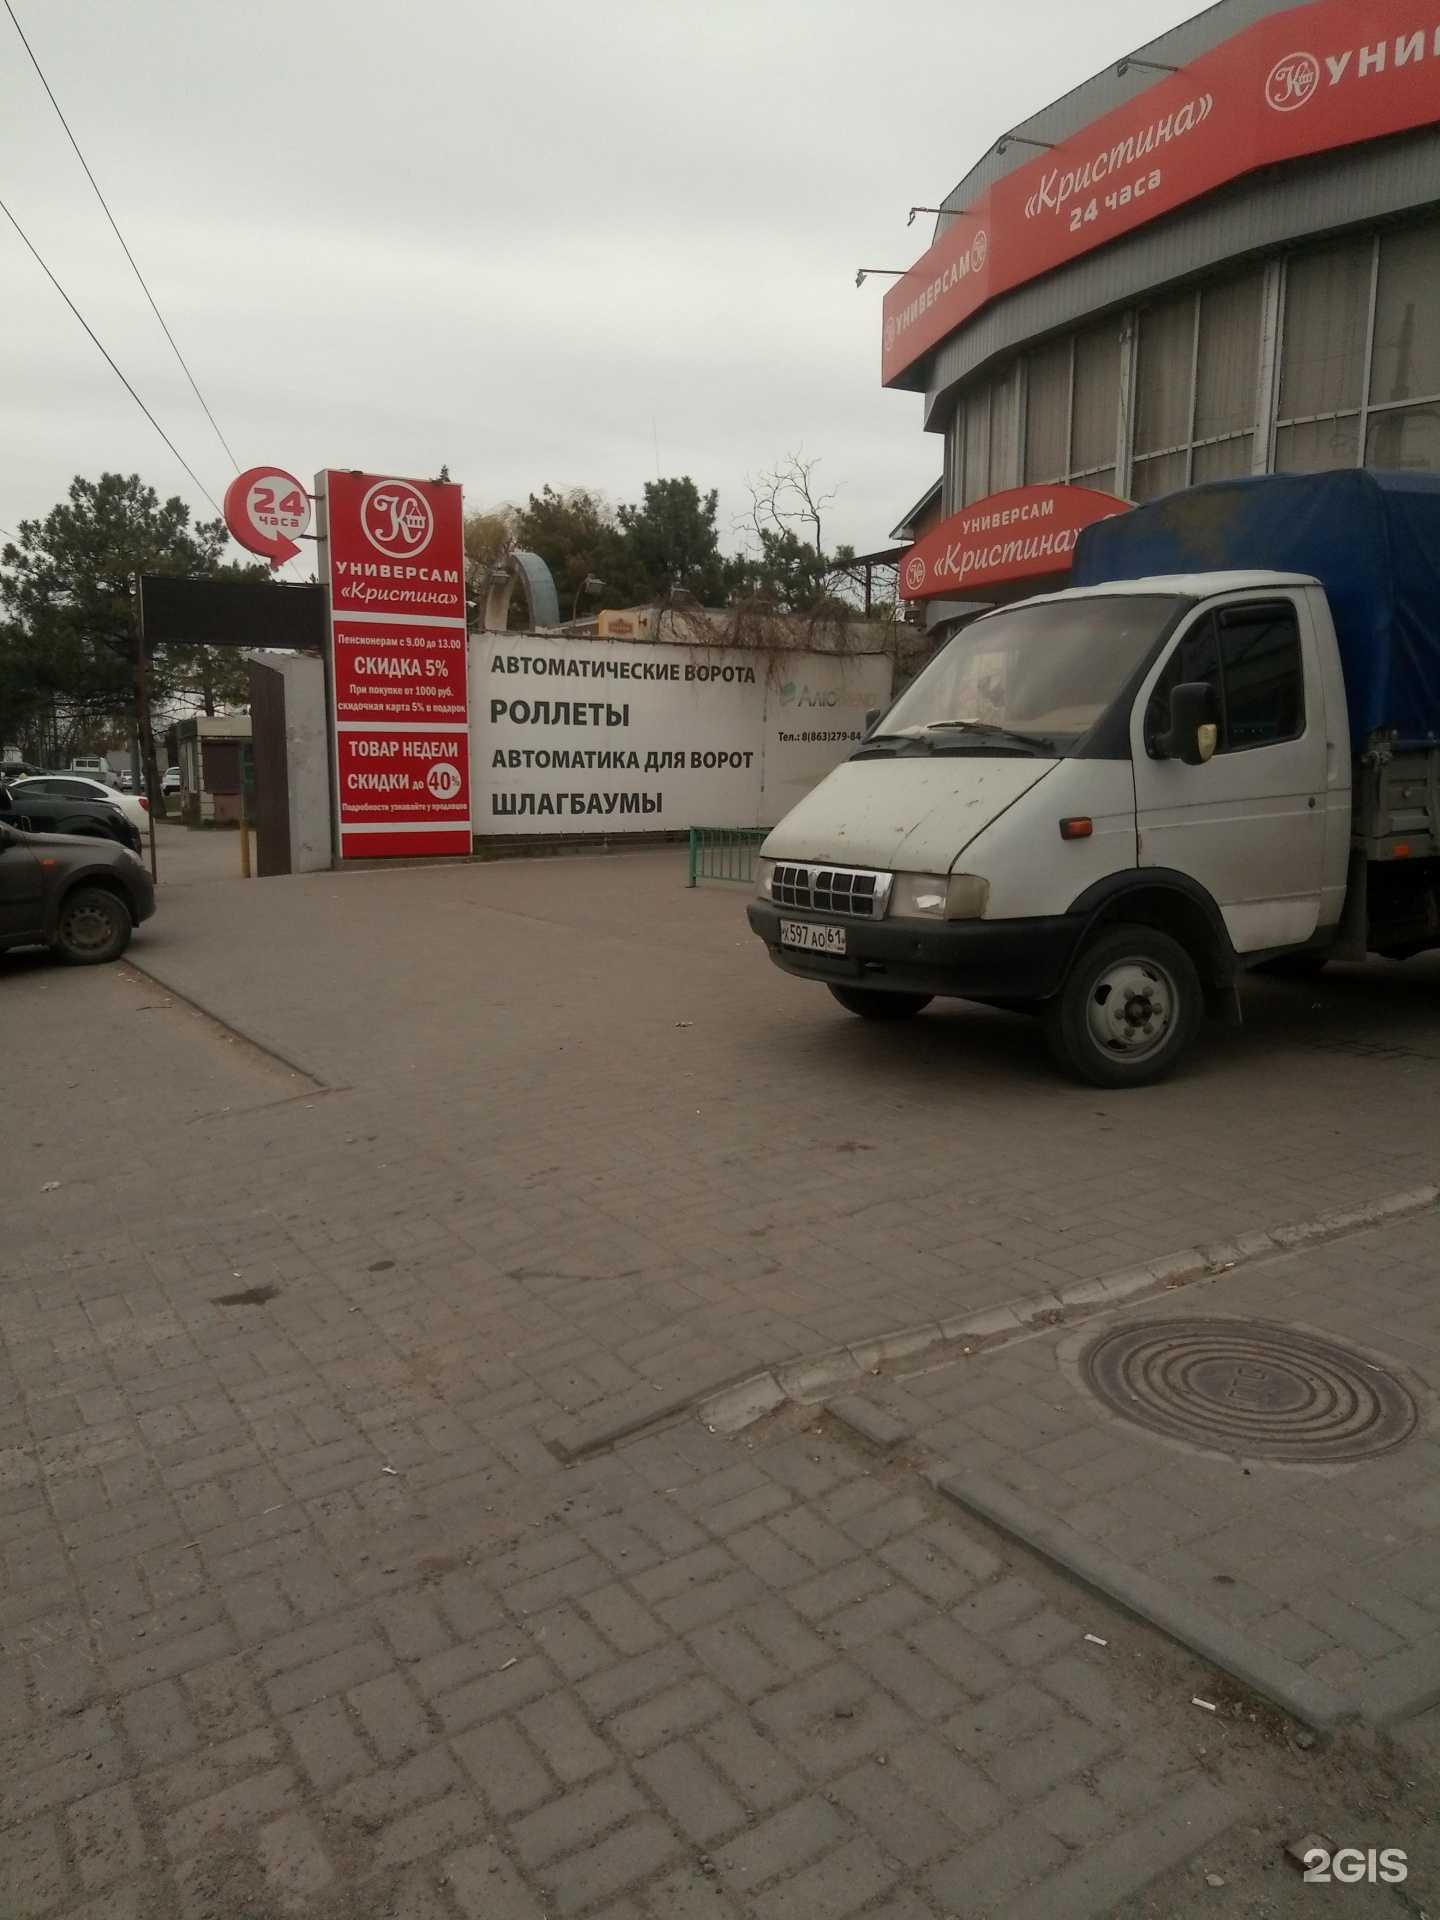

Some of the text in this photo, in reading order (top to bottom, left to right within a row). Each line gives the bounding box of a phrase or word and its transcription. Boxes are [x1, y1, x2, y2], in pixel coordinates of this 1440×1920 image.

[1024, 93, 1213, 219] «Кристина»
[1070, 169, 1161, 232] 24 часа
[896, 250, 971, 336] УНИВЕРСАМ
[254, 488, 304, 516] 24
[259, 516, 299, 527] часа
[962, 500, 1054, 534] УНИВЕРСАМ
[336, 561, 459, 583] УНИВЕРСАМ
[341, 581, 458, 604] «Кристина»
[338, 634, 398, 647] Пенсионерам
[406, 638, 425, 647] 9.00
[438, 640, 461, 649] 13.00
[354, 656, 449, 678] СКИДКА 5%
[490, 655, 756, 684] АВТОМАТИЧЕСКИЕ ВОРОТА
[350, 684, 367, 694] При
[368, 687, 402, 697] покупке
[415, 686, 436, 696] 1000
[438, 687, 454, 698] руб.
[386, 704, 410, 713] карта
[412, 702, 424, 711] 5%
[433, 704, 466, 714] подарок
[490, 699, 629, 727] РОЛЛЕТЫ
[778, 731, 800, 742] Тел.:
[349, 741, 458, 759] ТОВАР НЕДЕЛИ
[492, 750, 754, 773] АВТОМАТИКА ДЛЯ ВОРОТ
[347, 774, 409, 792] СКИДКИ
[412, 781, 424, 790] до
[491, 792, 663, 815] ШЛАГБАУМЫ
